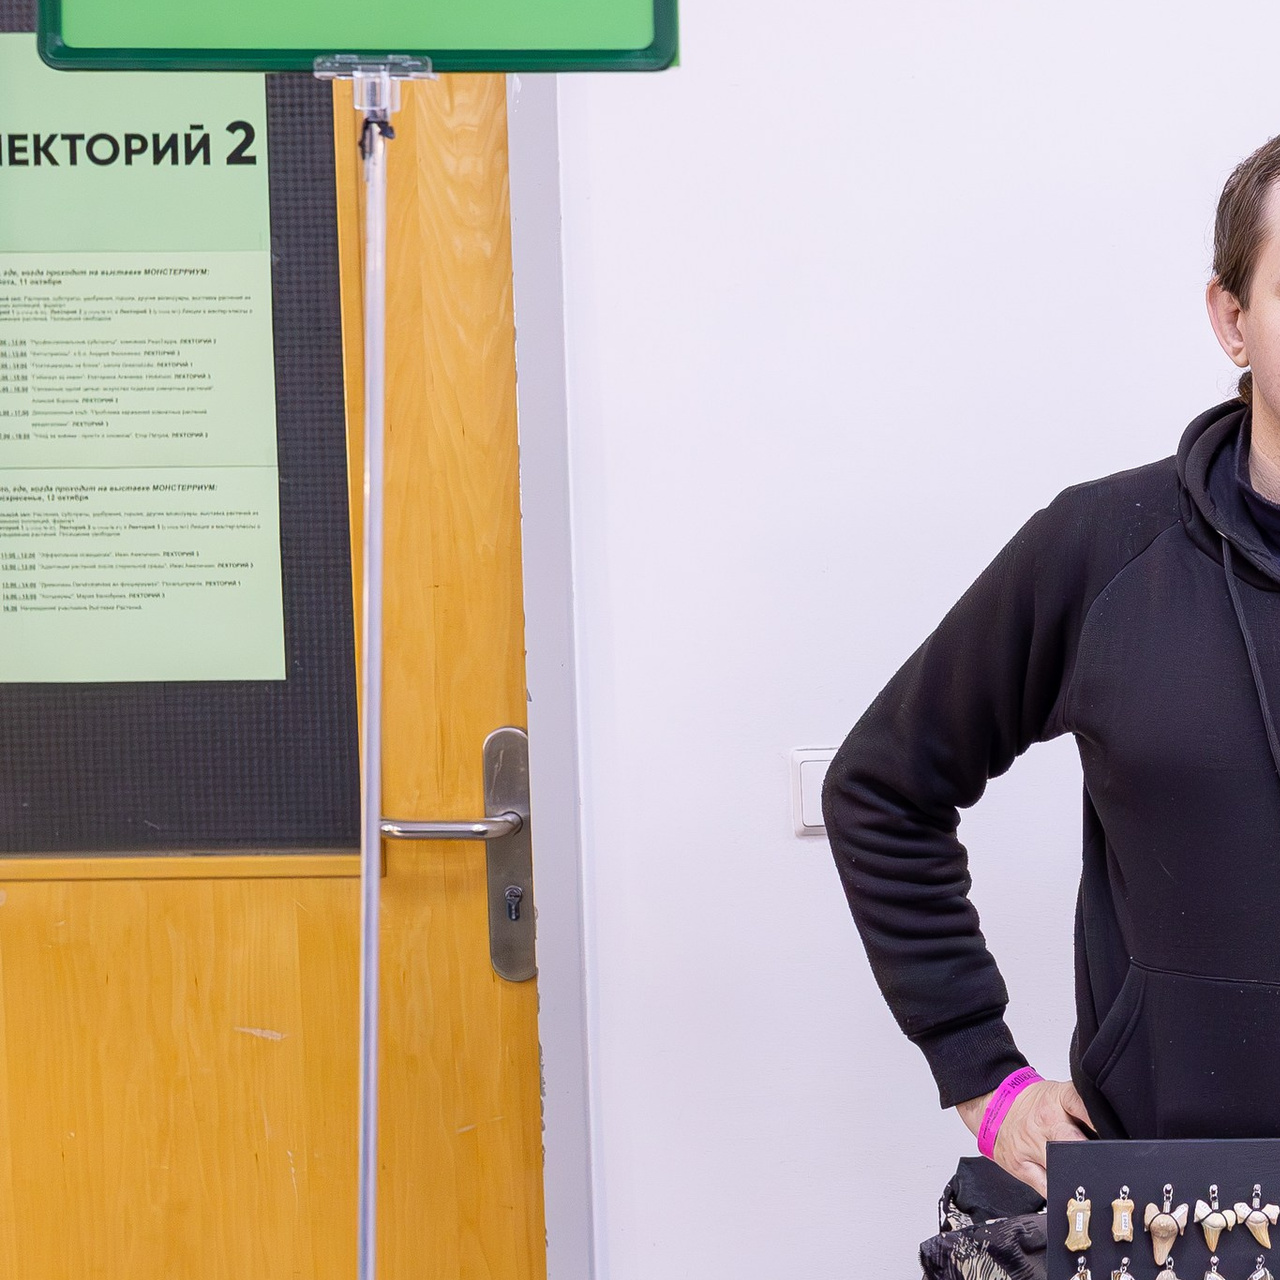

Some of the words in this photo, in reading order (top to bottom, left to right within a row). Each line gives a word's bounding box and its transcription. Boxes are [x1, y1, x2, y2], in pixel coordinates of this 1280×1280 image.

[0, 124, 211, 167] ЕКТОРИЙ
[225, 120, 258, 166] 2
[152, 483, 218, 492] МОНСТЕРРИУМ:
